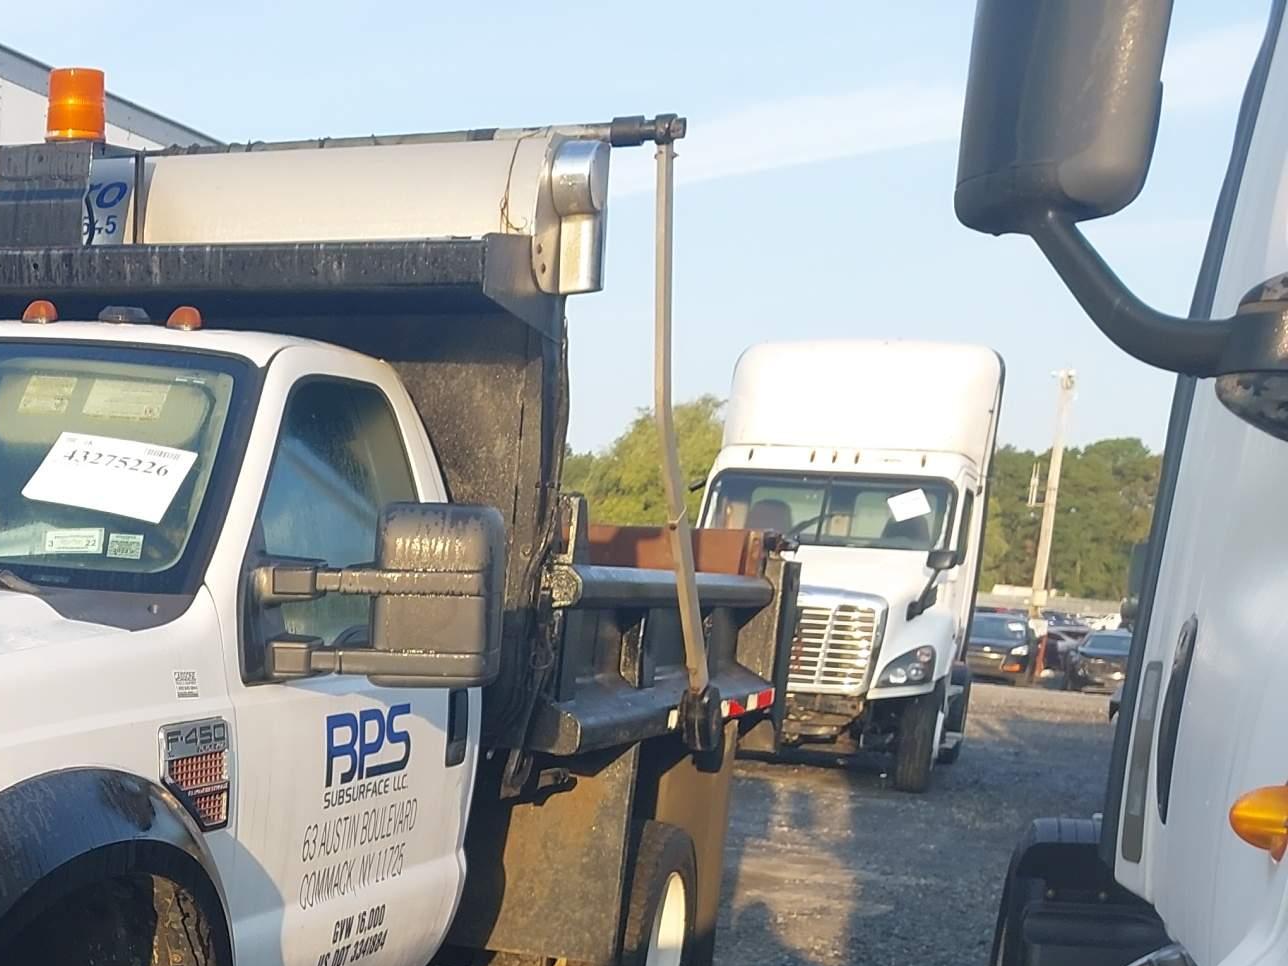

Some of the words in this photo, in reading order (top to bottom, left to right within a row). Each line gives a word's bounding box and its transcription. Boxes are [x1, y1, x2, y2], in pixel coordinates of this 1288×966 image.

[64, 449, 169, 477] 43275226
[323, 778, 390, 809] SUBSURFACE
[302, 824, 319, 862] 63
[318, 814, 360, 857] AUSTIN
[360, 798, 418, 846] BOULEVARD
[358, 851, 376, 889] NY
[375, 843, 406, 884] 11725
